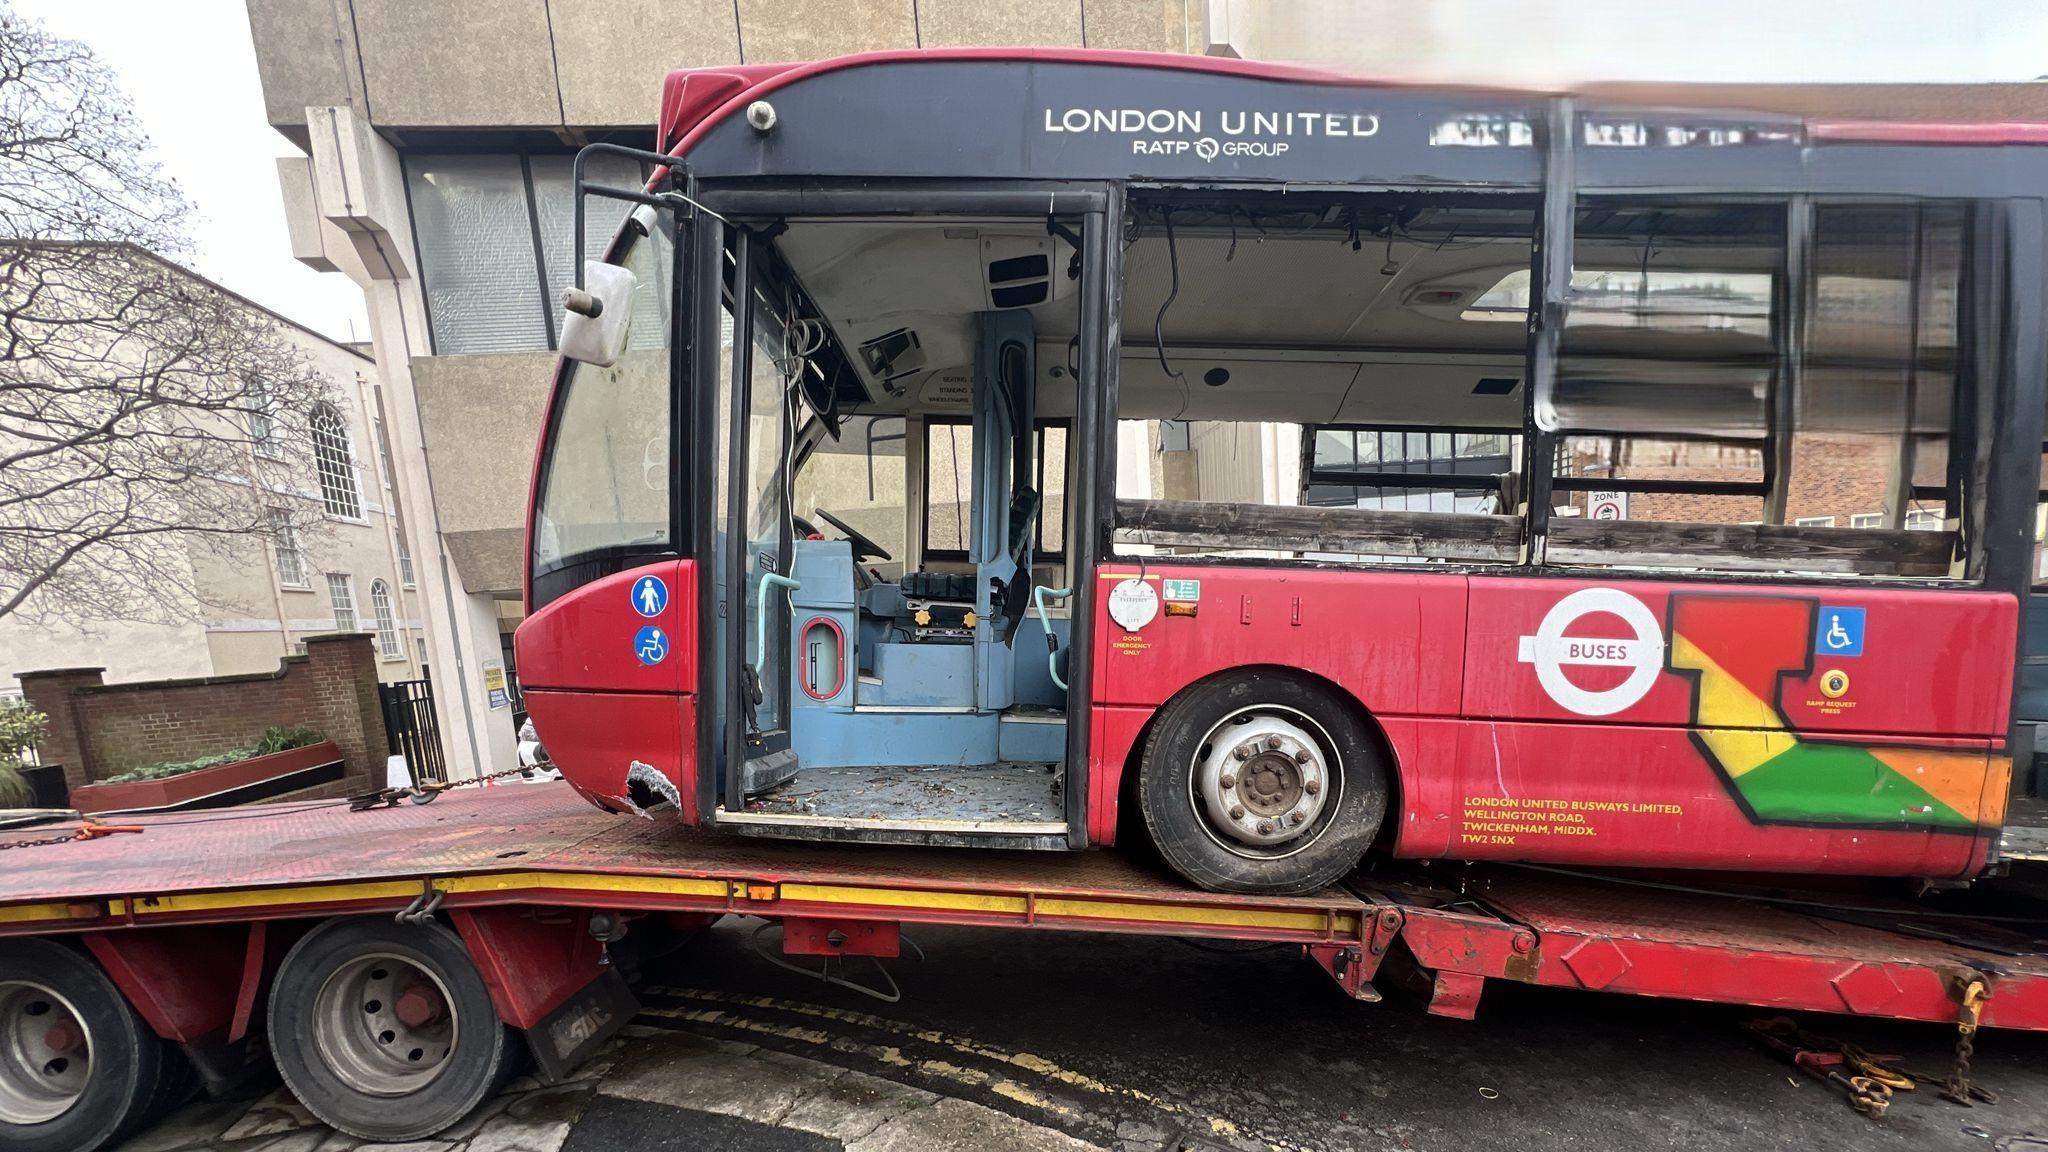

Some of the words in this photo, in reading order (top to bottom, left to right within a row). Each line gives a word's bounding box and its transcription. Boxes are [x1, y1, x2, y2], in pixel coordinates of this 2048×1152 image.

[1045, 108, 1201, 133] LONDON
[1221, 111, 1380, 136] UNITED
[1133, 140, 1190, 155] RATP
[1222, 142, 1289, 157] GROUP
[1594, 492, 1619, 501] ZONE
[1570, 643, 1627, 660] BUSES
[1464, 797, 1519, 808] LONDON
[1522, 799, 1568, 810] UNITED
[1571, 801, 1629, 812] BUSWAYS
[1632, 803, 1684, 816] LIMITED,
[1464, 809, 1546, 822] WELLINGTON
[1549, 812, 1586, 824] ROAD,
[1462, 822, 1551, 835] TWICKENHAM,
[1553, 826, 1598, 836] MIDDX.
[1461, 834, 1488, 844] TW2
[1491, 835, 1516, 845] 5NX
